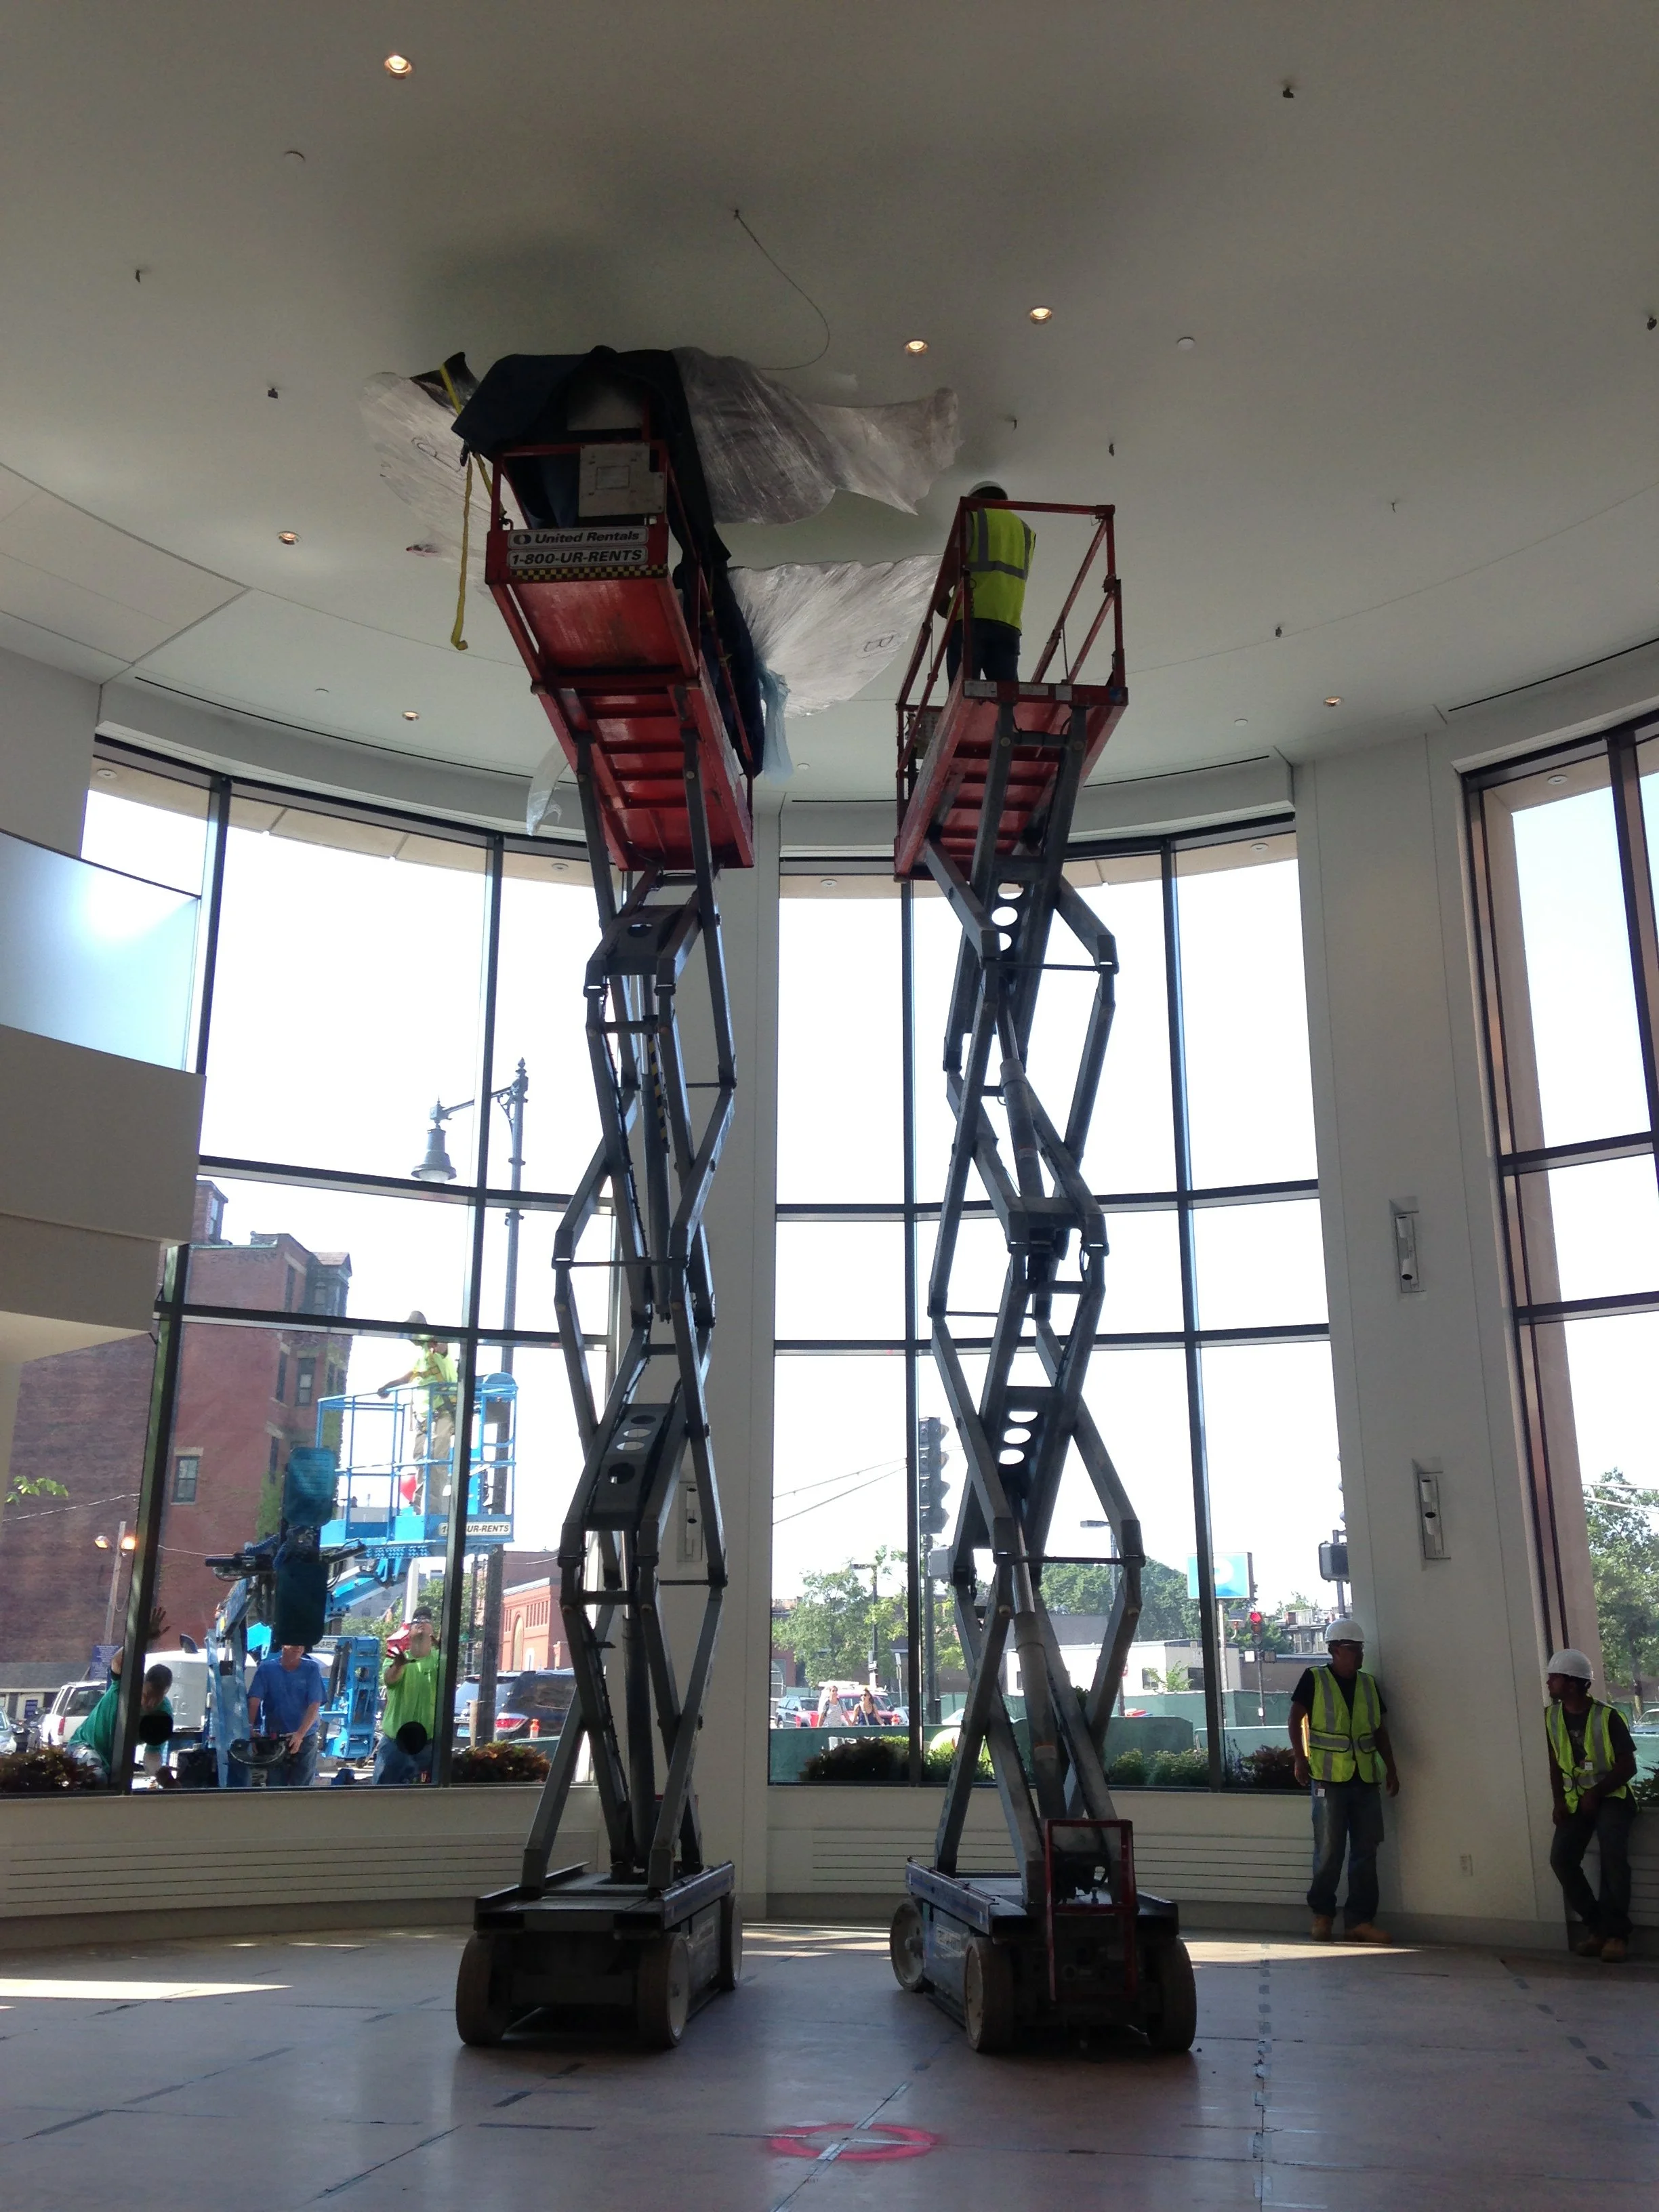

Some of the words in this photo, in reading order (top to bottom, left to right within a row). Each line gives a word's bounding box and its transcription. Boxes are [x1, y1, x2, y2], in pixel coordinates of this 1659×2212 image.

[535, 533, 583, 544] United
[587, 531, 639, 541] Rentals
[512, 550, 642, 565] 1-800-UR-RENTS
[442, 1525, 509, 1533] 1UR-RENTS
